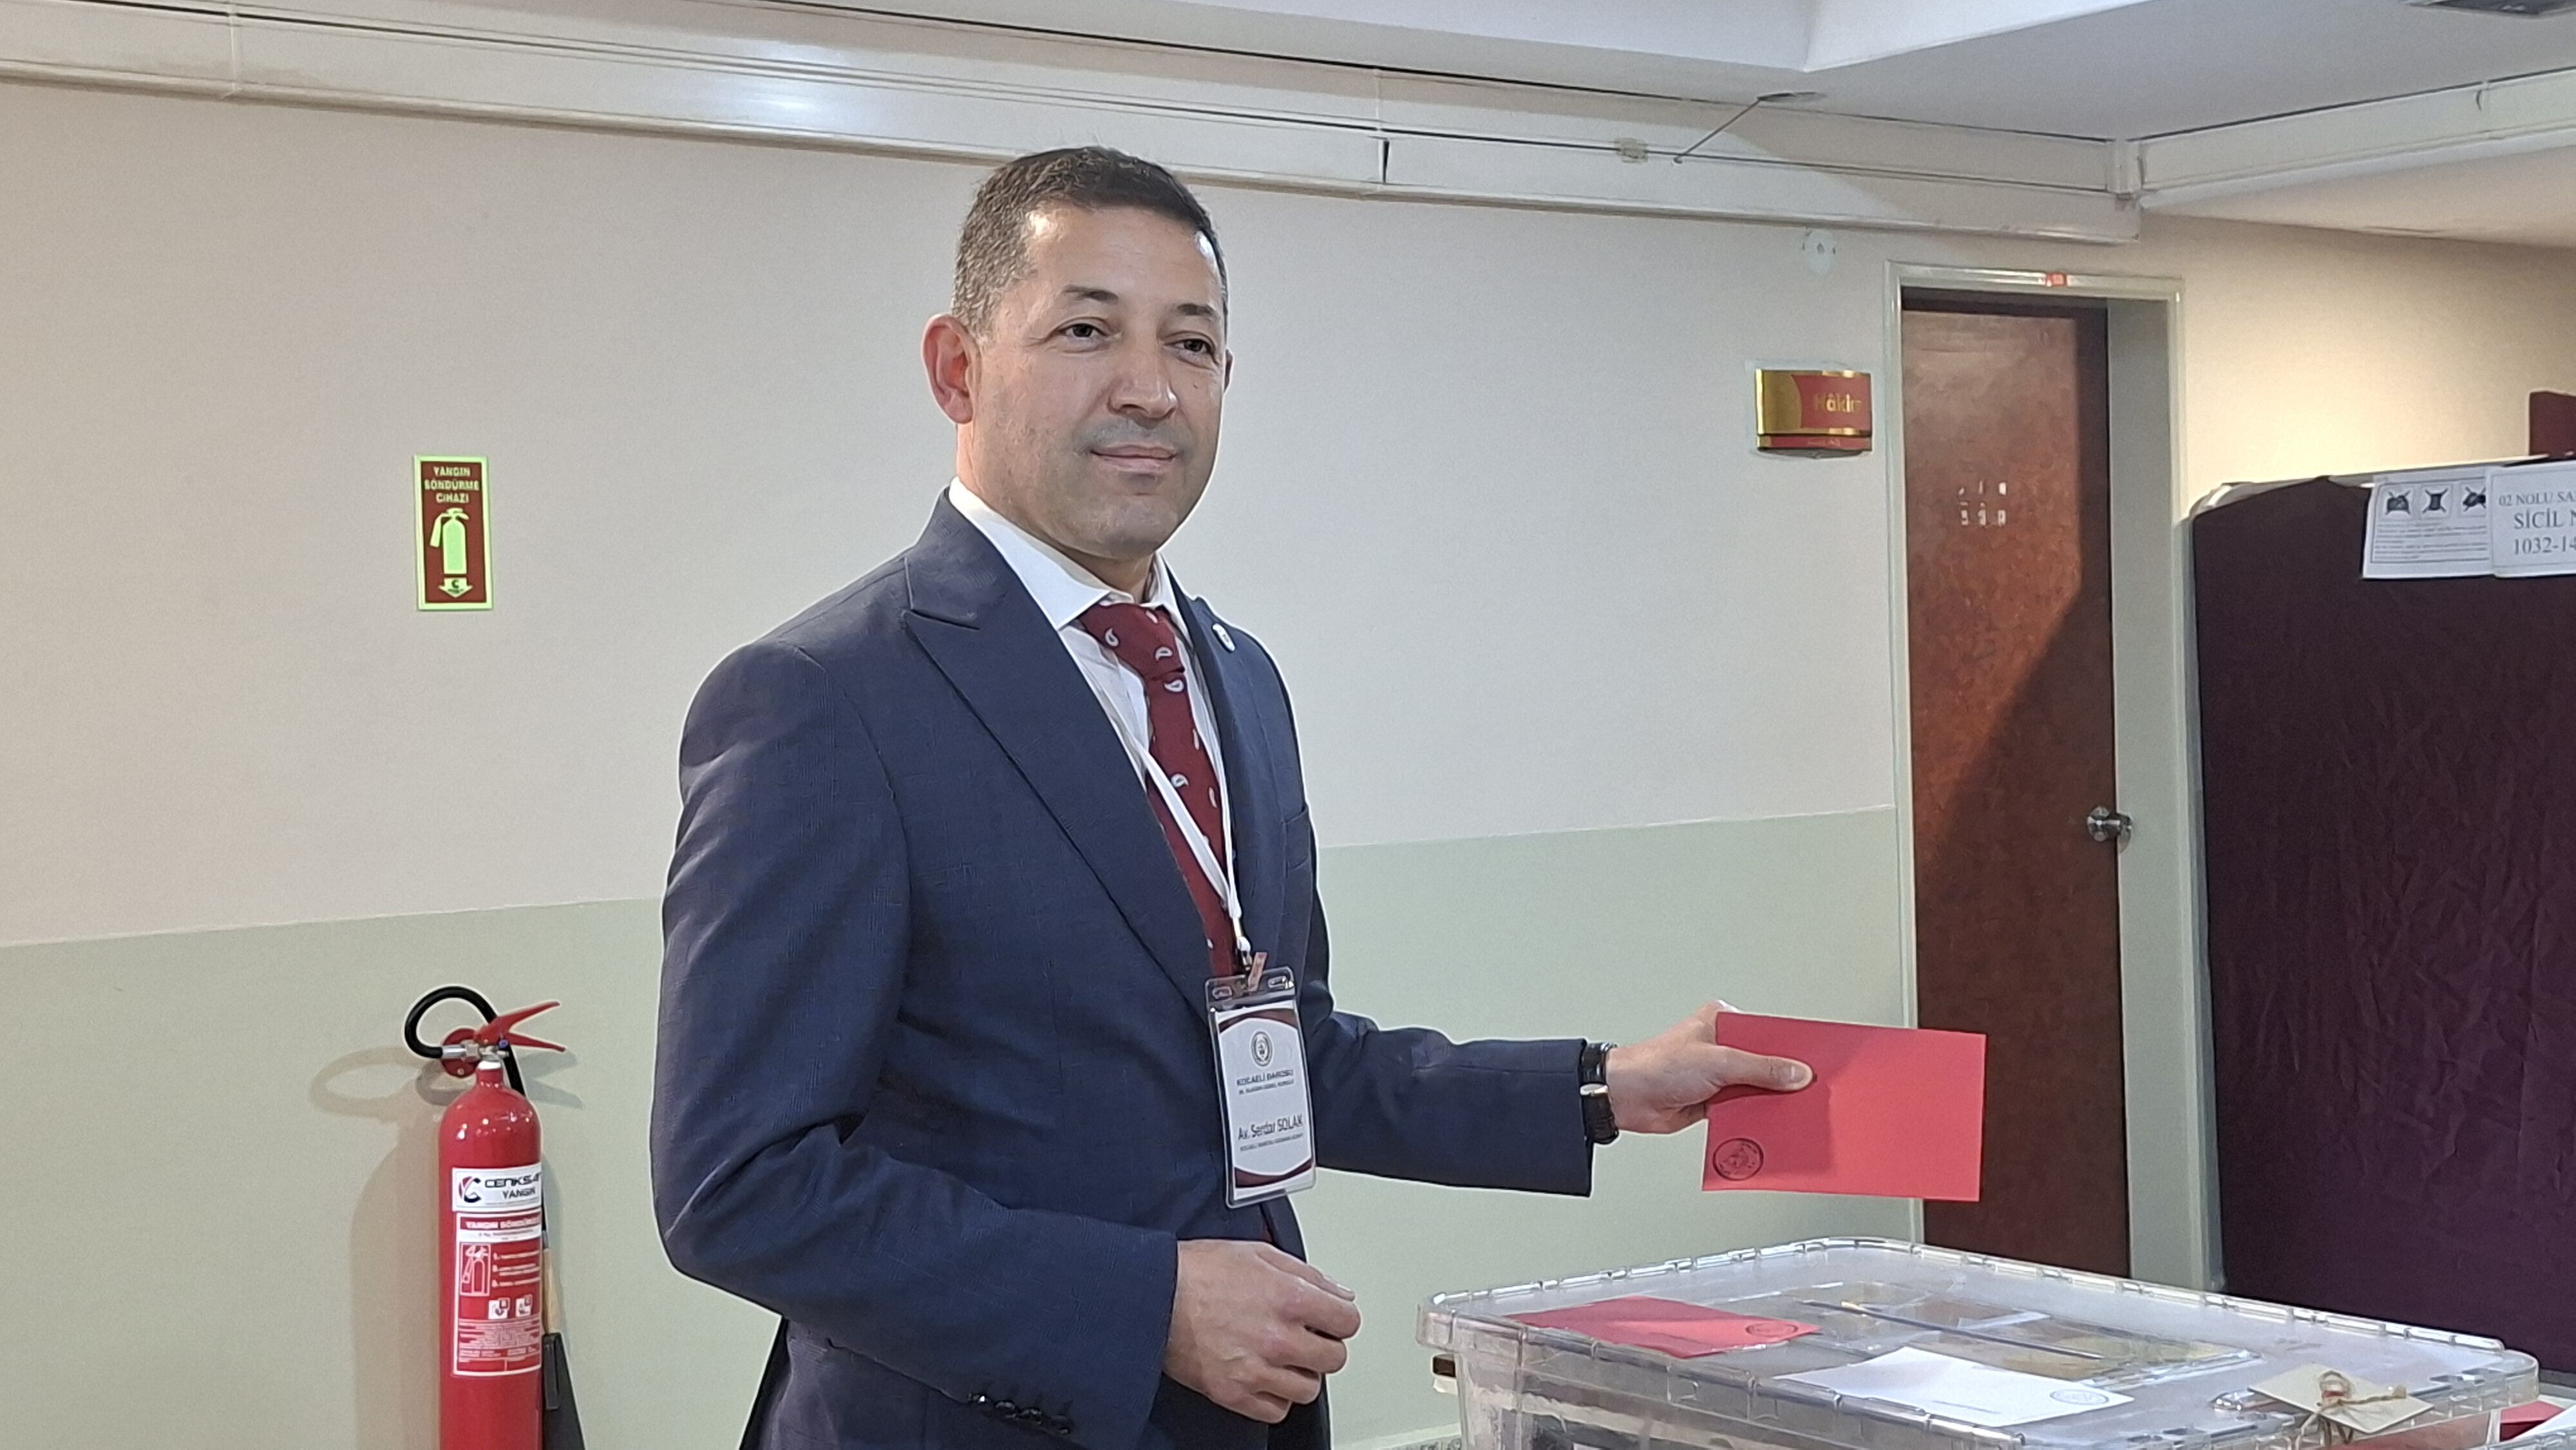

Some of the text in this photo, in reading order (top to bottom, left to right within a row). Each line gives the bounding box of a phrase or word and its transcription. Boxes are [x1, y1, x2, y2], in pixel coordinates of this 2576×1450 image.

[433, 466, 471, 477] YANGIN
[2499, 494, 2512, 506] 02
[2516, 492, 2553, 505] NOLU
[2514, 507, 2564, 529] SİCİL
[1276, 1113, 1304, 1133] SOLAK
